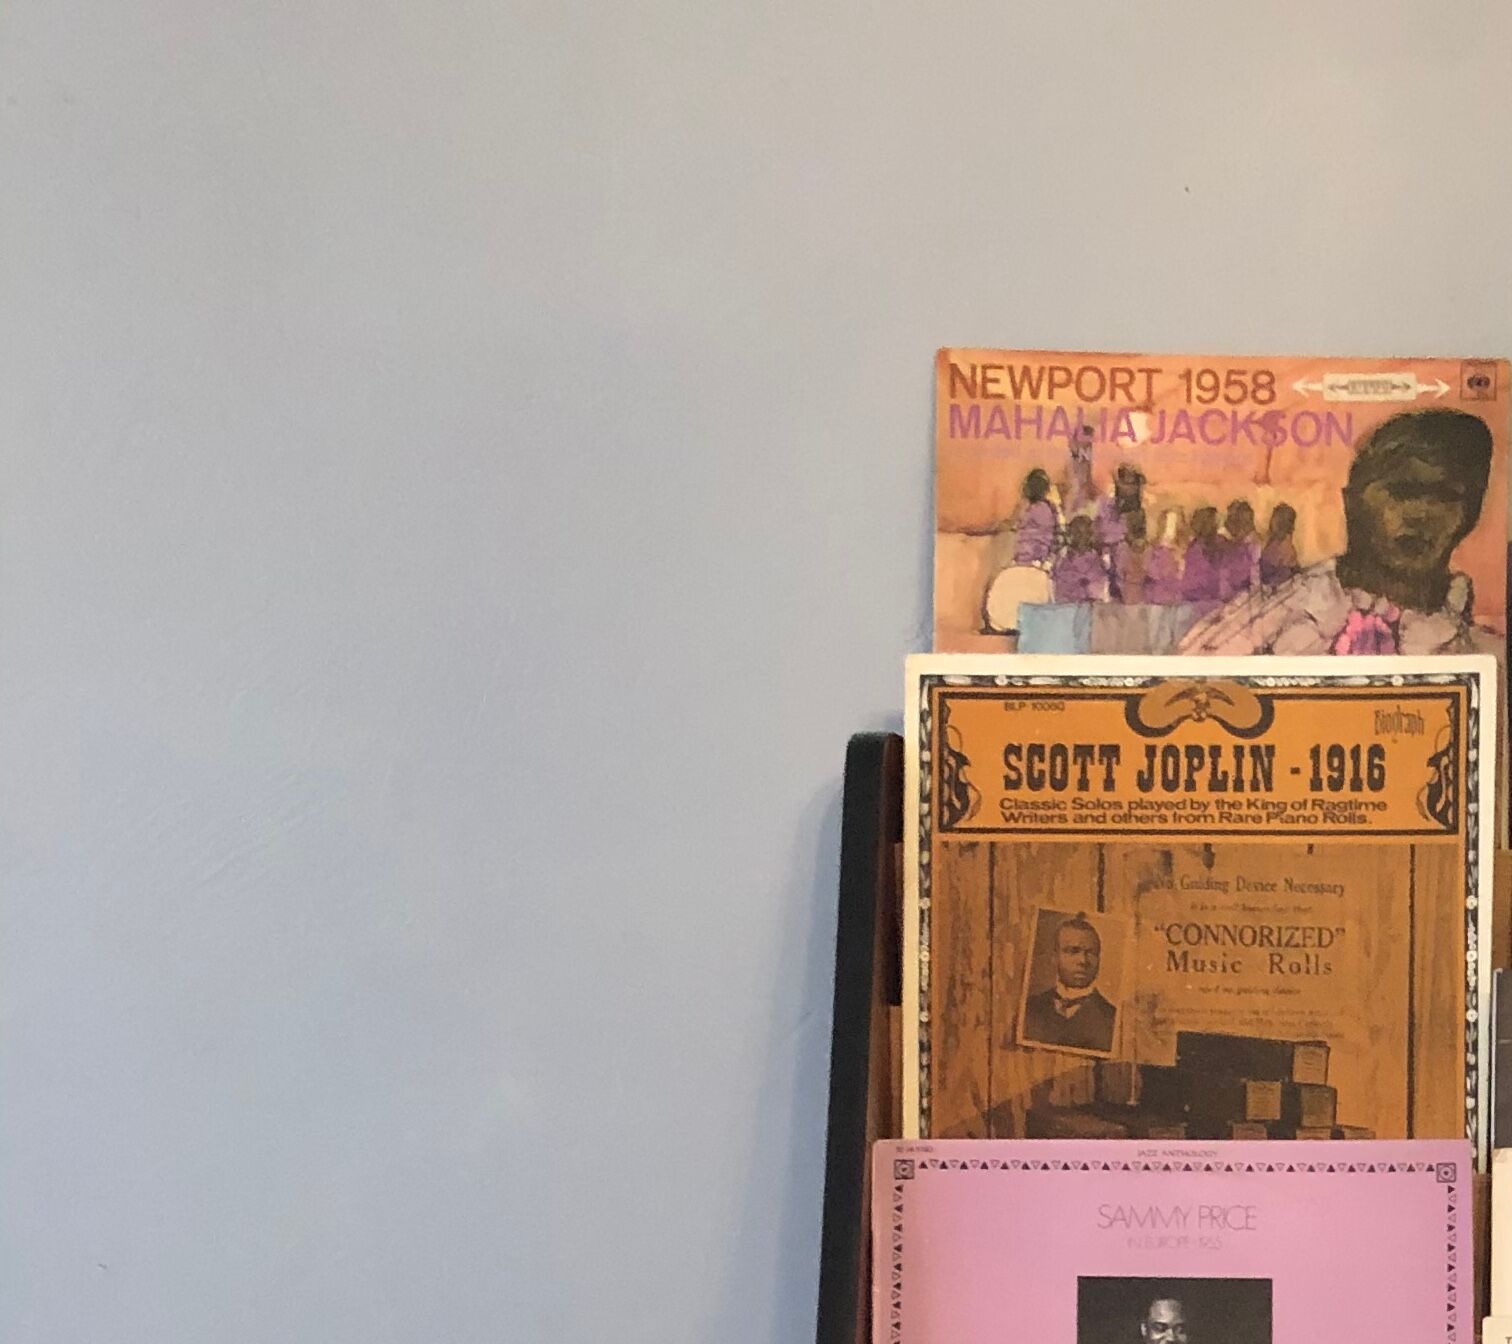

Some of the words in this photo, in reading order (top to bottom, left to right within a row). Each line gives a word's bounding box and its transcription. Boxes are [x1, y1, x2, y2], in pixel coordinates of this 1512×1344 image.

[949, 363, 1163, 402] NEWPORT
[1183, 368, 1276, 405] 1958
[949, 404, 1136, 444] MAHALIA
[1150, 408, 1354, 448] JACKSON
[1003, 743, 1121, 792] SCOTT
[1137, 743, 1276, 793] JOPLIN
[1309, 743, 1387, 793] 1916
[1000, 797, 1067, 811] Classic
[1072, 797, 1123, 811] Solos
[1128, 798, 1187, 814] played
[1190, 799, 1210, 814] by
[1215, 799, 1242, 811] the
[1246, 799, 1287, 814] King
[1290, 799, 1308, 811] of
[1312, 799, 1387, 813] Ragtime
[1001, 811, 1068, 824] Writers
[1073, 811, 1107, 824] and
[1111, 811, 1168, 824] others
[1172, 811, 1215, 824] from
[1219, 811, 1262, 824] Rare
[1267, 811, 1318, 824] Piano
[1322, 811, 1373, 825] Rolls.
[1236, 875, 1278, 893] Device
[1284, 877, 1345, 897] Necessary
[1166, 950, 1243, 974] Music
[1269, 952, 1333, 976] Rolls
[1097, 1203, 1192, 1230] SAMMY
[1198, 1204, 1257, 1231] PRICE
